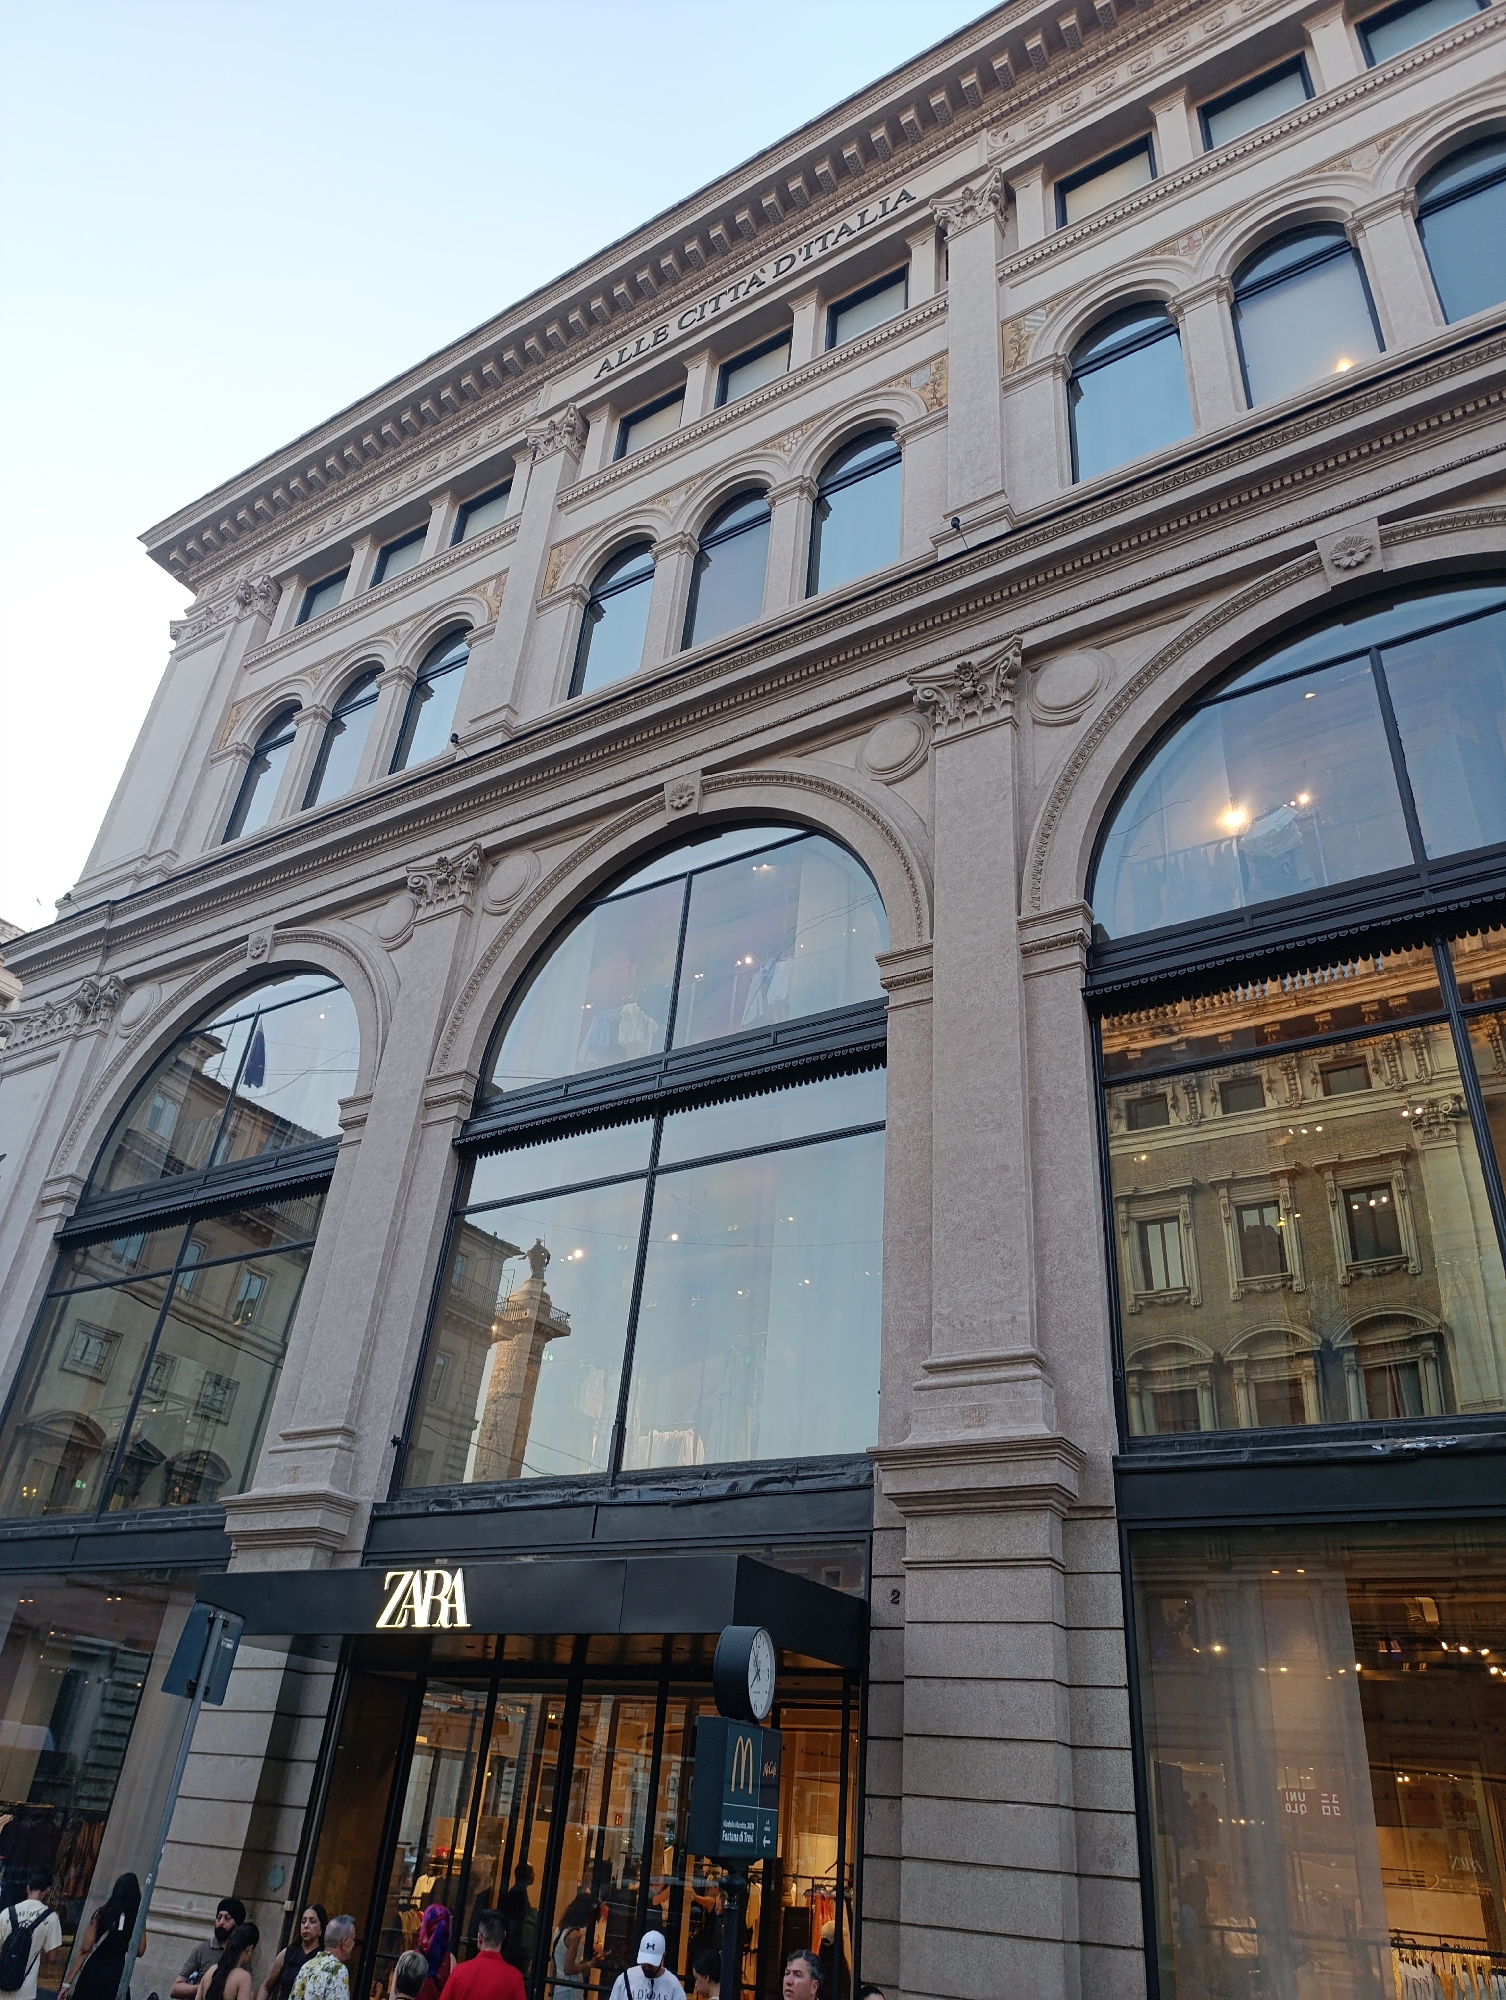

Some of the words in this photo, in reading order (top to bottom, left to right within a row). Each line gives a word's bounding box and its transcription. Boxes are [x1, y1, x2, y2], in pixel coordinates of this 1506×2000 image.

[594, 324, 670, 379] ALLE
[772, 188, 916, 278] D'ITALIA
[376, 1567, 472, 1628] ZARA
[890, 1589, 901, 1605] 2
